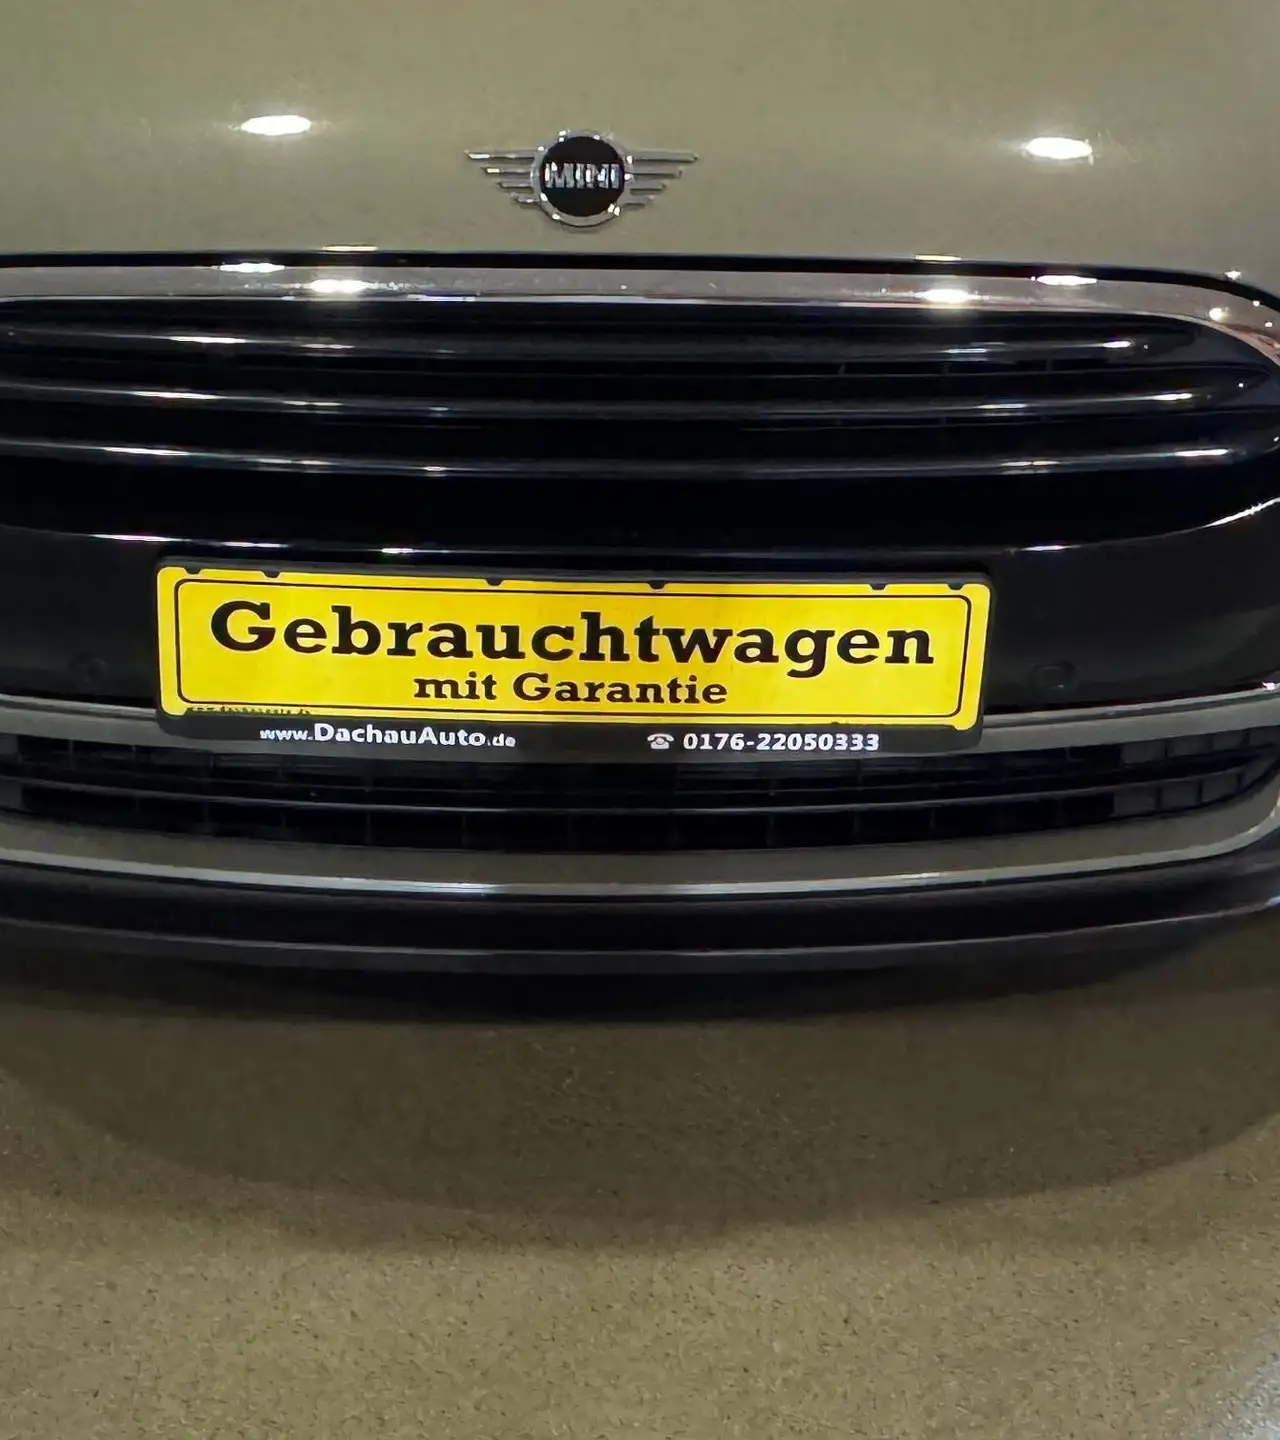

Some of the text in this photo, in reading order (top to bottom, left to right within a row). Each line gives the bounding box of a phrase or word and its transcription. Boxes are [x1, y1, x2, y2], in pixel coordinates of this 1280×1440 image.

[544, 161, 620, 188] MINI
[210, 600, 934, 679] Gebrauchtwagen
[413, 671, 729, 705] mit Garantie
[259, 722, 880, 752] www.DachauAuto.de 0176-22050333
